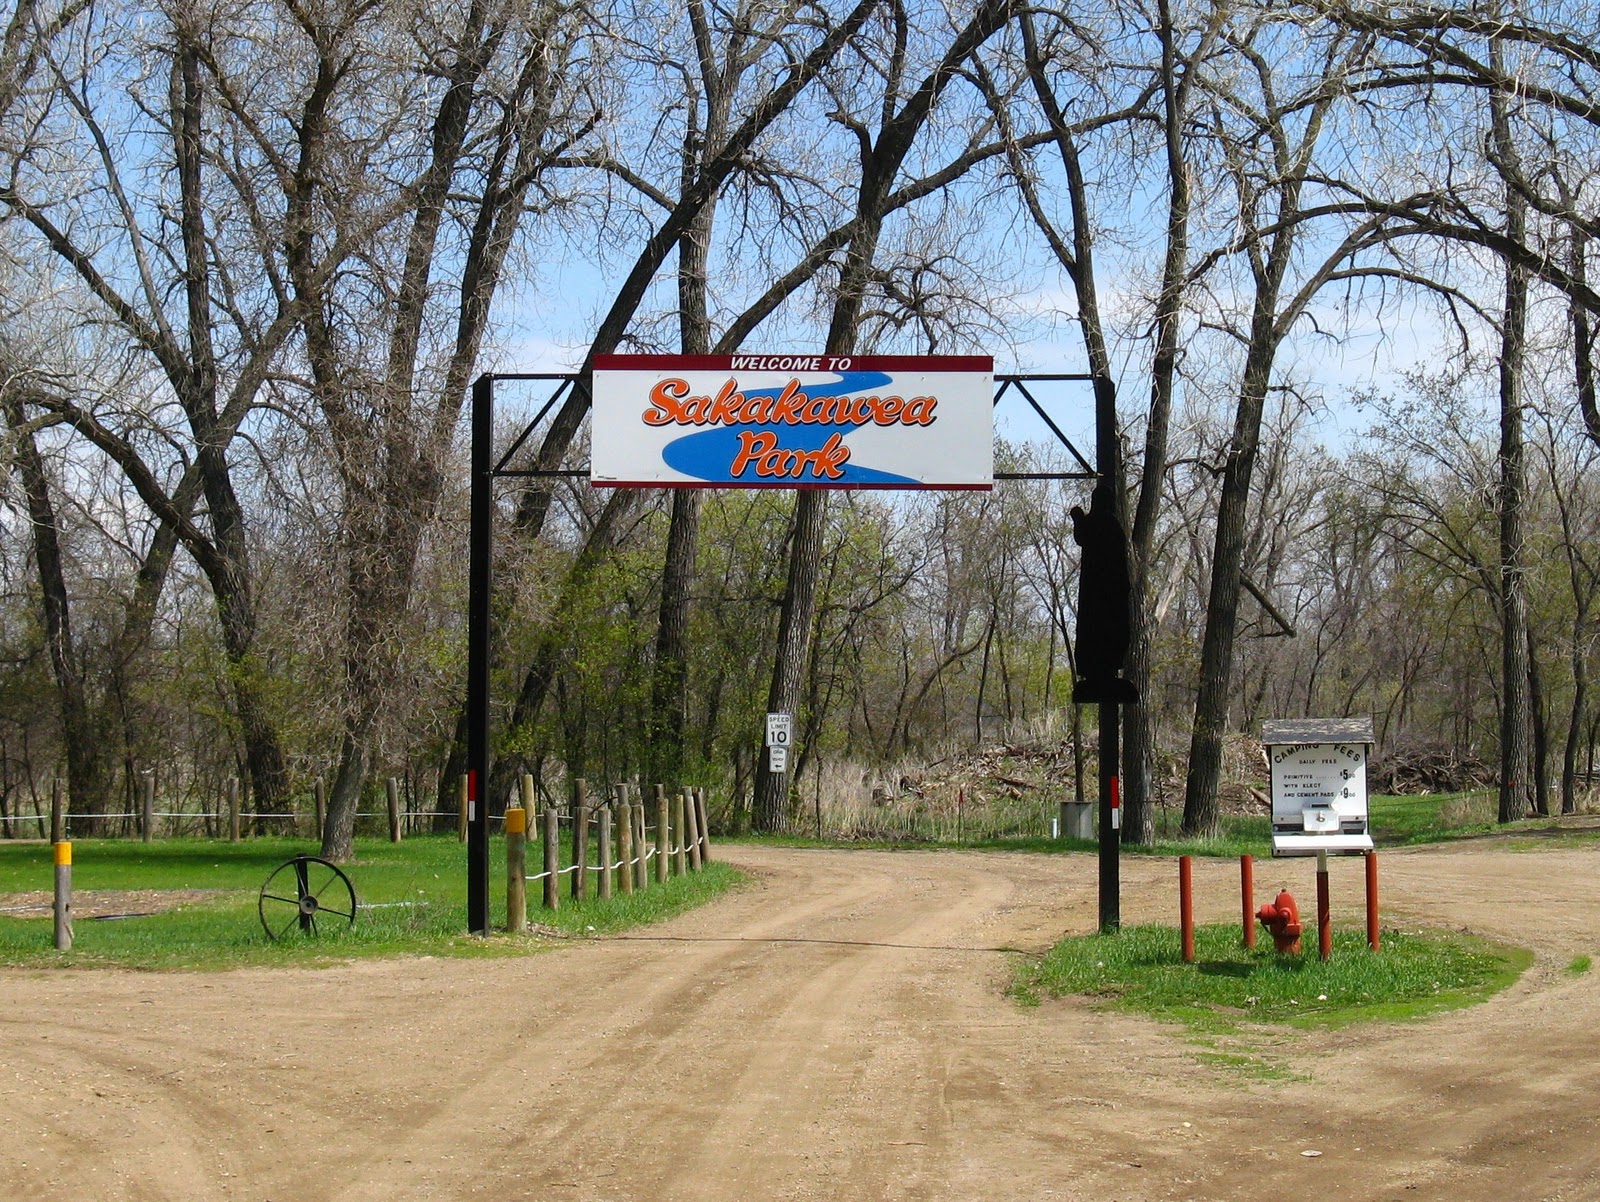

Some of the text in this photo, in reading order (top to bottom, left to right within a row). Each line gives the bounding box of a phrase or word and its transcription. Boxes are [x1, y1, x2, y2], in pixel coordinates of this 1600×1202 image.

[730, 356, 852, 371] WELCOME TO
[642, 377, 939, 427] Sakakawea
[729, 430, 851, 479] Park
[771, 731, 787, 743] 10
[1333, 744, 1361, 762] FEES
